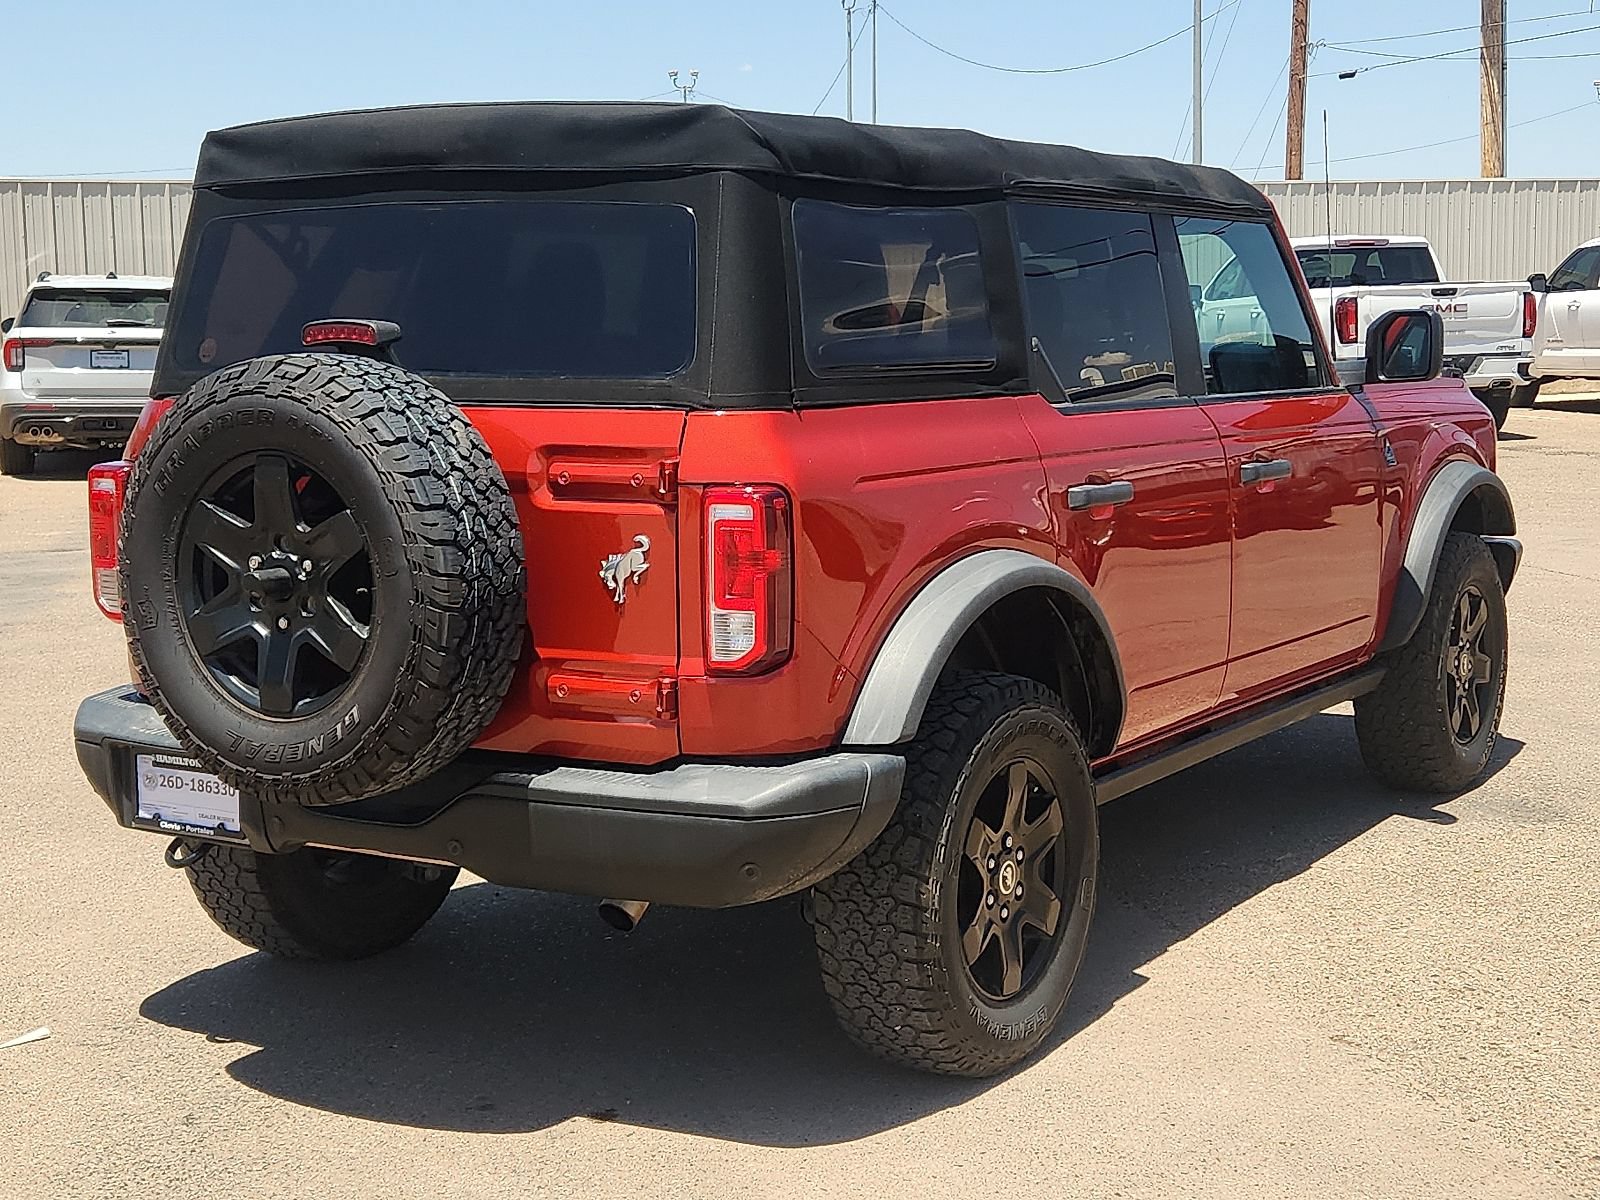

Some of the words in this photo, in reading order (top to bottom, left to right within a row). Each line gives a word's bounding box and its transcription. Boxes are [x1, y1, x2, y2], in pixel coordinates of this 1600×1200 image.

[1420, 303, 1468, 313] GMC
[224, 703, 361, 764] GENERAL
[156, 753, 202, 768] HAMILTON
[185, 825, 215, 836] Portales
[968, 1003, 1048, 1041] GENERAL
